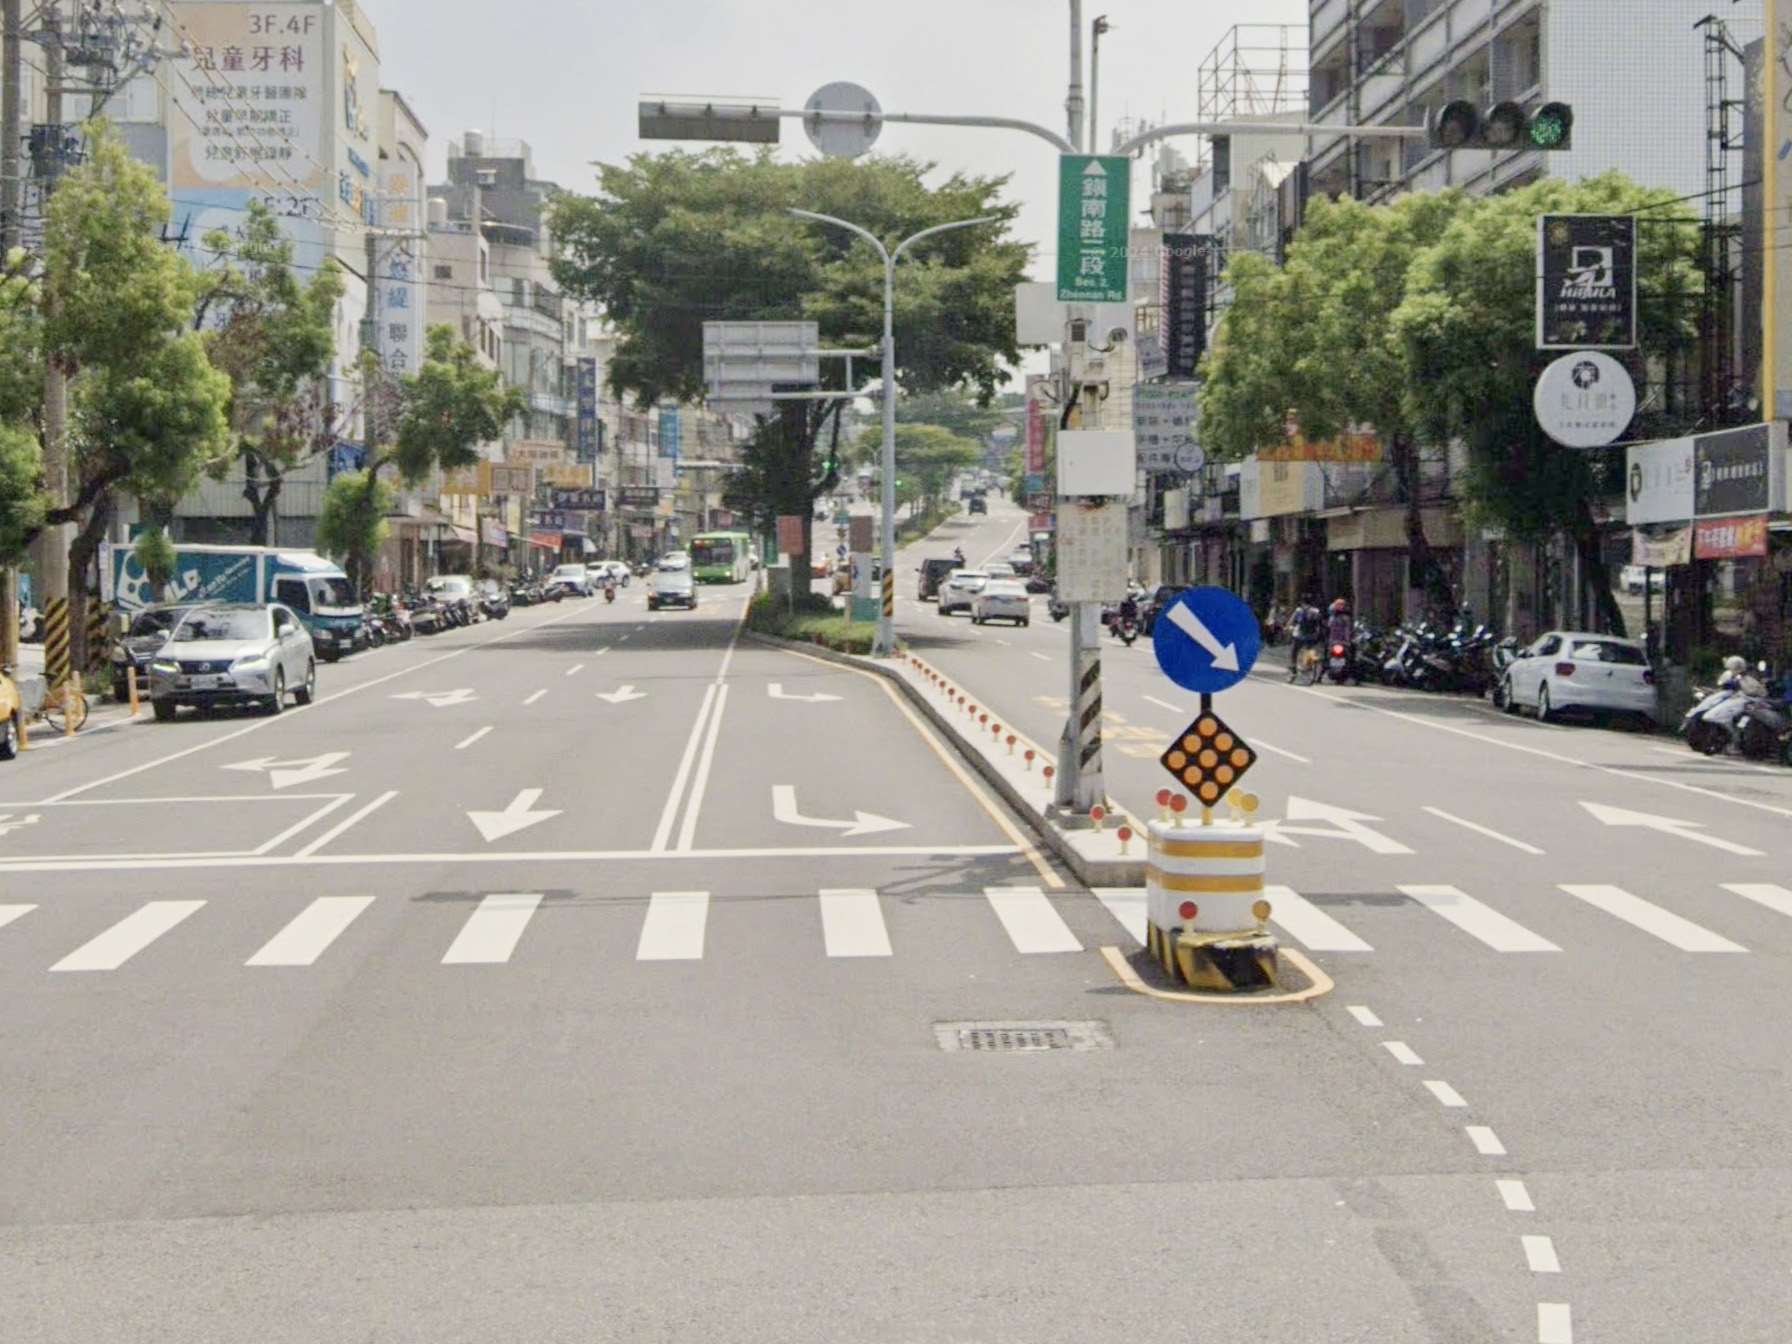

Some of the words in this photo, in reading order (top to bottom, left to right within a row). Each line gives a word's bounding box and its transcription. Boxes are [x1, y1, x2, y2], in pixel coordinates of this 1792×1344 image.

[249, 14, 316, 35] 3F.4F
[191, 44, 305, 73] 兒童牙科
[1079, 177, 1108, 276] 鎮南路二段
